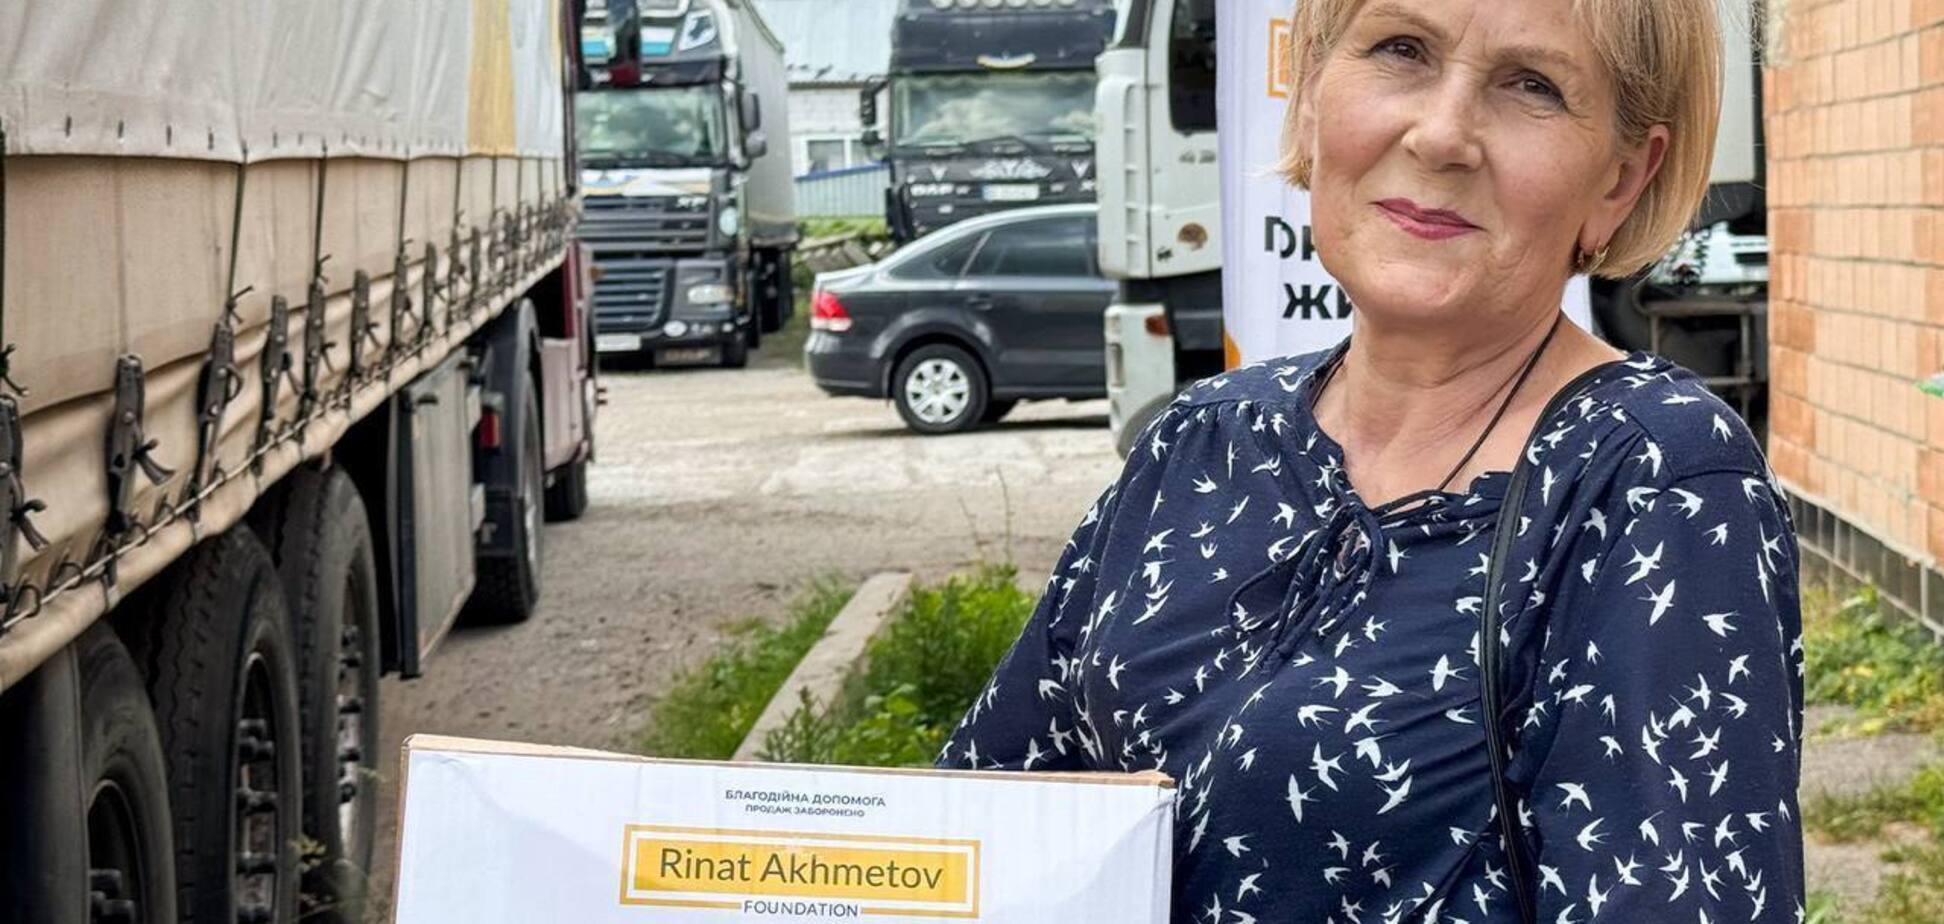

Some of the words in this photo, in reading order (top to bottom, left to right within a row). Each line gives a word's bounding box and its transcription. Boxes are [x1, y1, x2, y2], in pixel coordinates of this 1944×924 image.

[725, 789, 809, 804] БЛАГОДІЙНА
[812, 793, 886, 807] ДОПОМОГА
[745, 804, 792, 815] ПРОДАЖ
[794, 807, 865, 818] ЗАБОРОНЕНО
[660, 848, 752, 882] Rinat
[759, 853, 944, 890] Akhmetov
[743, 900, 859, 918] FOUNDATION
